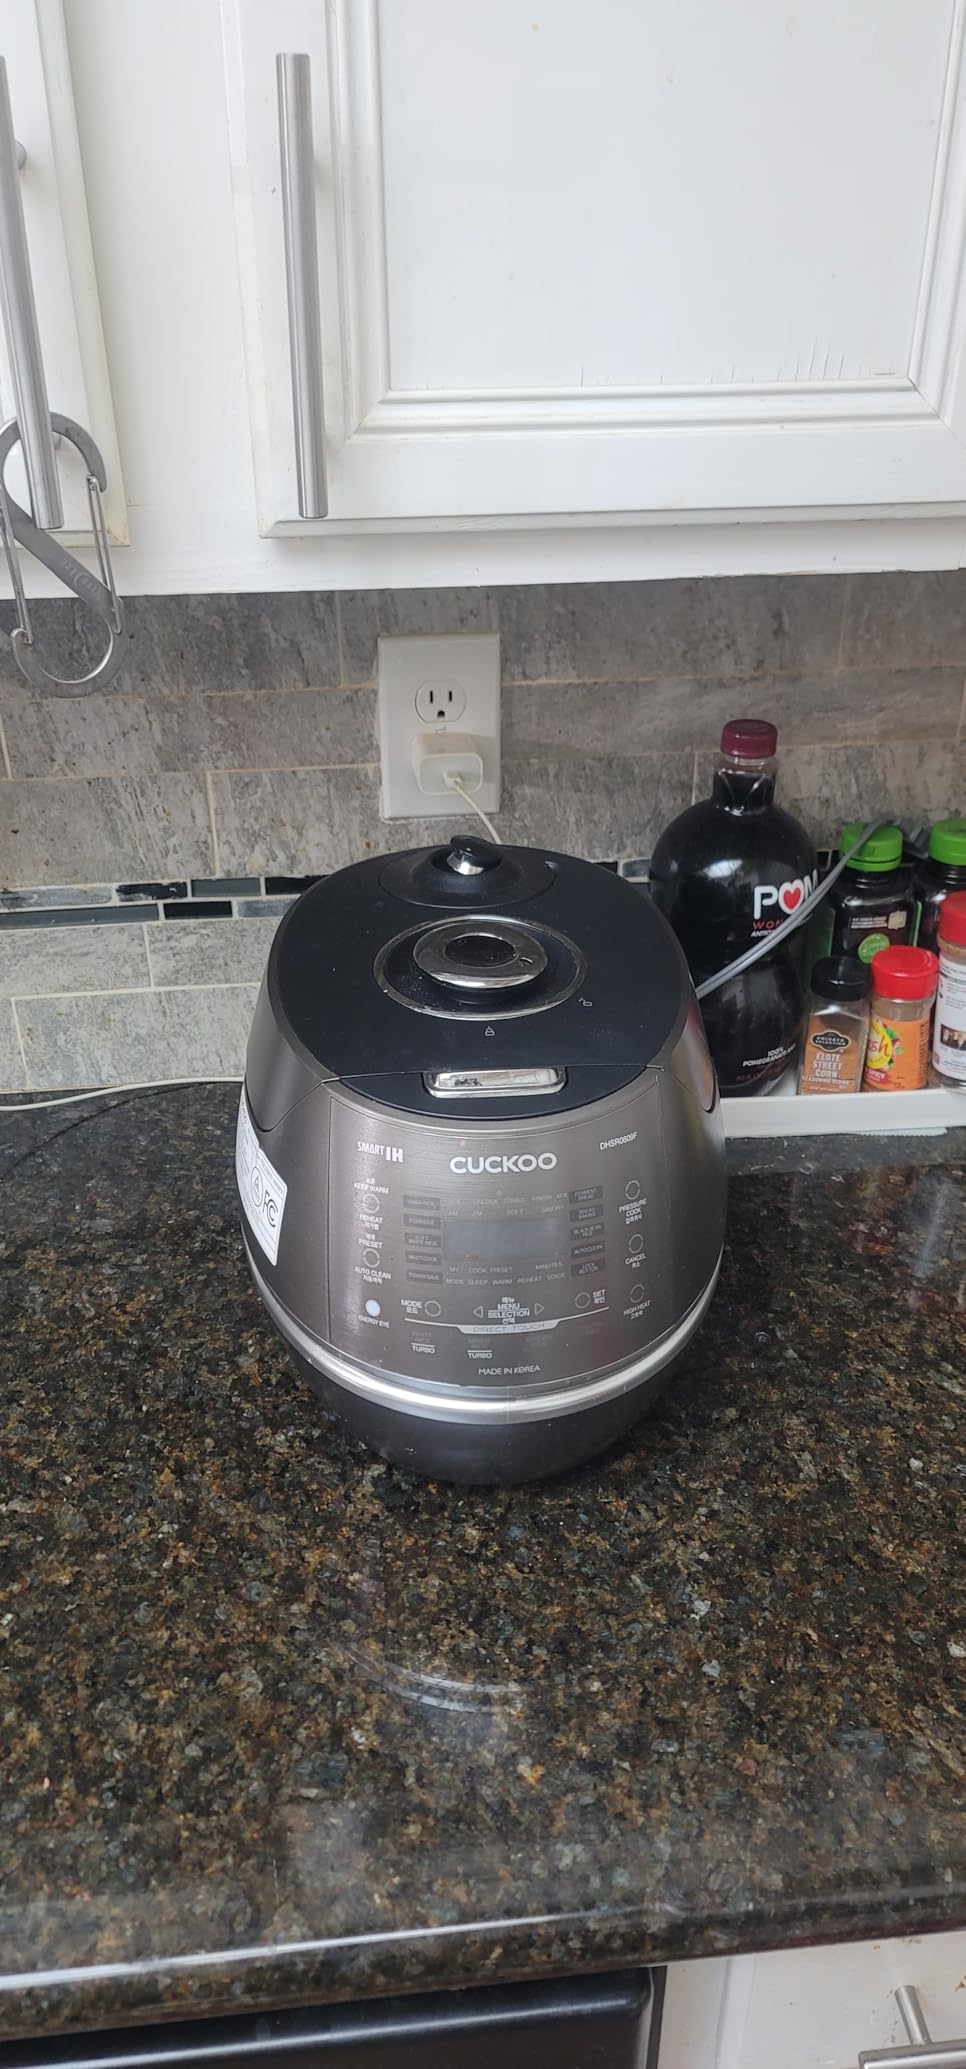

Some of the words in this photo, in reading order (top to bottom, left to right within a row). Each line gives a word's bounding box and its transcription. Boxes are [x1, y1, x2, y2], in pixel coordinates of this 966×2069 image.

[816, 1053, 841, 1062] ELOTE
[812, 1061, 844, 1070] STREET
[815, 1070, 838, 1079] CORN
[357, 1141, 385, 1156] SMART
[385, 1146, 404, 1163] IH
[450, 1152, 558, 1174] CUCKOO
[354, 1182, 369, 1191] KEEP
[369, 1185, 389, 1194] WARM
[619, 1198, 647, 1213] PRESSURE
[626, 1207, 642, 1217] COOK
[360, 1214, 383, 1224] REHEAT
[359, 1239, 382, 1249] PRESET
[625, 1253, 646, 1265] CANCEL
[354, 1266, 370, 1276] AUTO
[371, 1270, 391, 1280] CLEAN
[593, 1289, 606, 1298] SET
[401, 1299, 422, 1309] MODE
[497, 1302, 520, 1310] MENU
[488, 1310, 530, 1319] SELECTION
[358, 1315, 378, 1325] ENERGY
[379, 1320, 390, 1328] EYE
[472, 1325, 508, 1333] DIRECT
[512, 1322, 546, 1332] TOUCH
[411, 1345, 436, 1354] TURBO
[468, 1352, 493, 1360] TURBO
[478, 1366, 502, 1376] MADE
[504, 1366, 513, 1375] IN
[514, 1365, 541, 1374] KOREA
